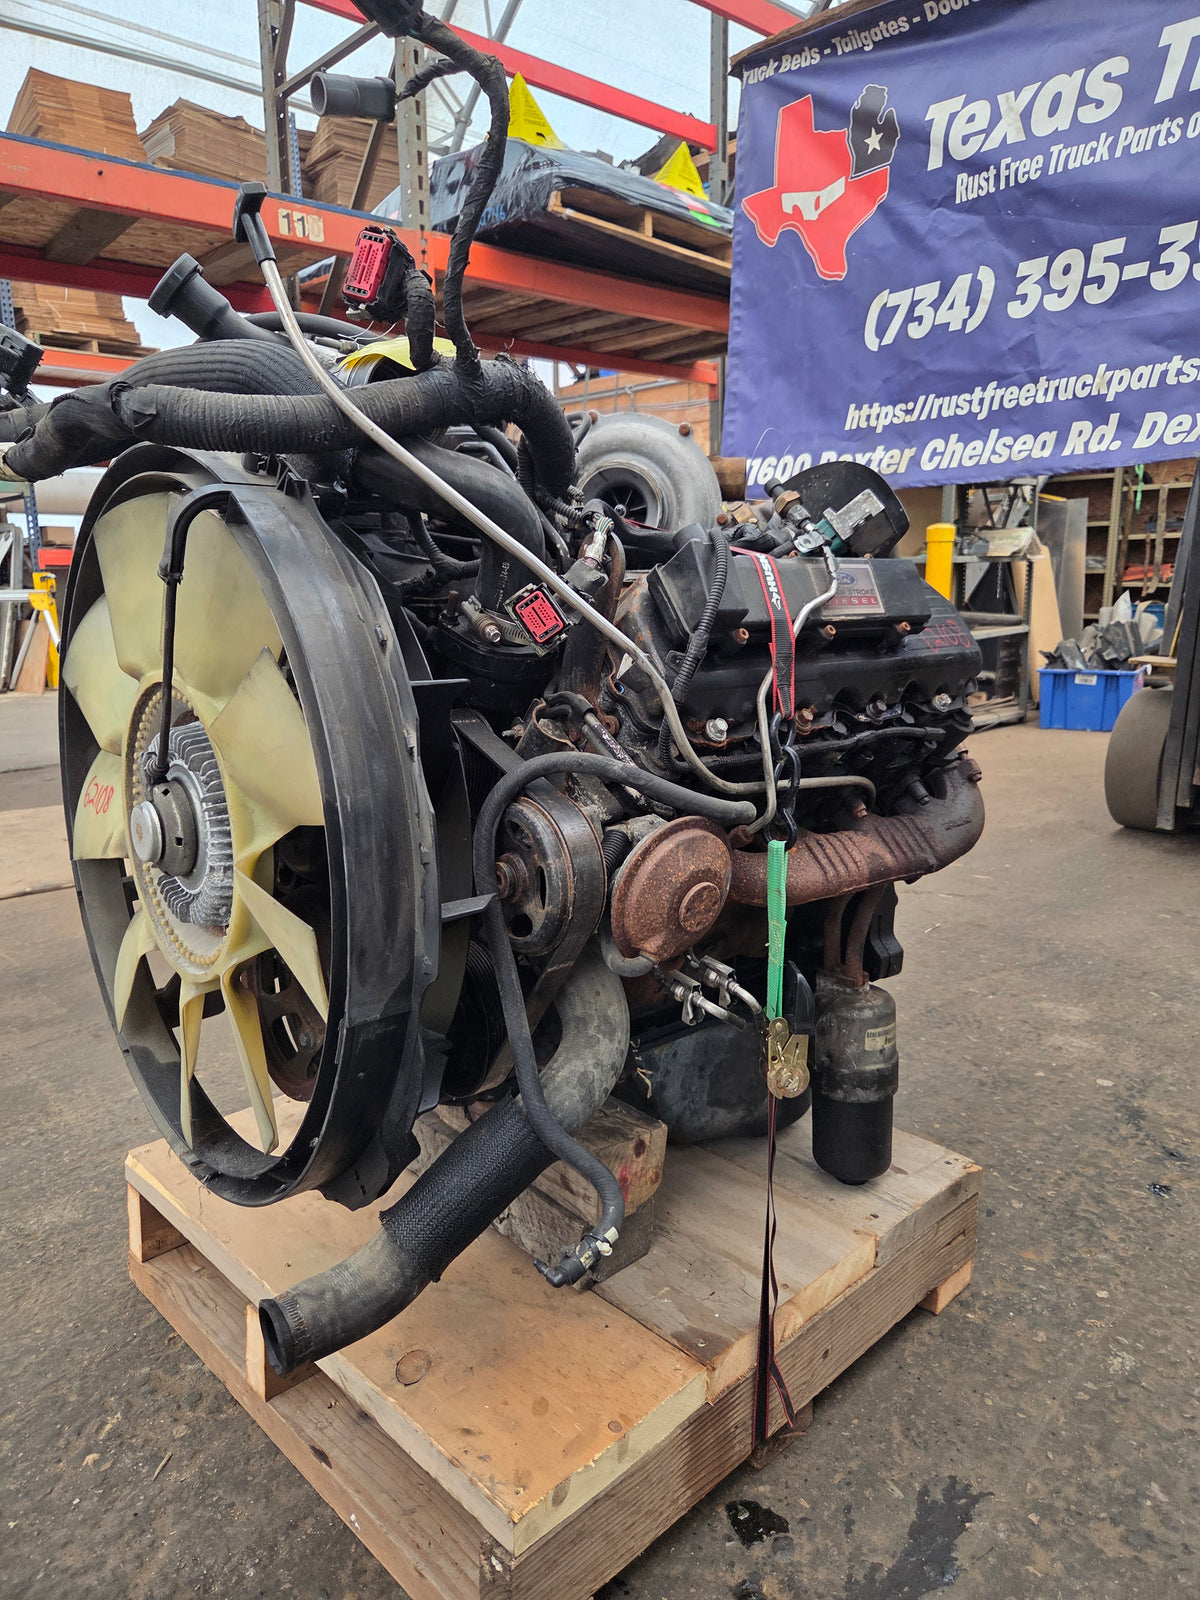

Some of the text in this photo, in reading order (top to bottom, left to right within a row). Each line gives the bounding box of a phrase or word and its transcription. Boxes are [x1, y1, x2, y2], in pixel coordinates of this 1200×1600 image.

[742, 60, 779, 90] ruck
[779, 46, 821, 74] Beds
[832, 15, 910, 56] Tailgates
[924, 0, 980, 22] Doo
[925, 15, 1200, 172] Texas T
[955, 161, 996, 204] Rust
[1000, 152, 1042, 191] Free
[1048, 131, 1115, 177] Truck
[1114, 116, 1185, 159] Parts
[864, 219, 1200, 352] (734) 395-3
[844, 354, 1200, 432] https://rustfreetruckparts
[746, 453, 812, 486] 1600
[920, 428, 1057, 471] Chelsea
[1061, 412, 1122, 457] Rd.
[827, 596, 879, 607] IESEL
